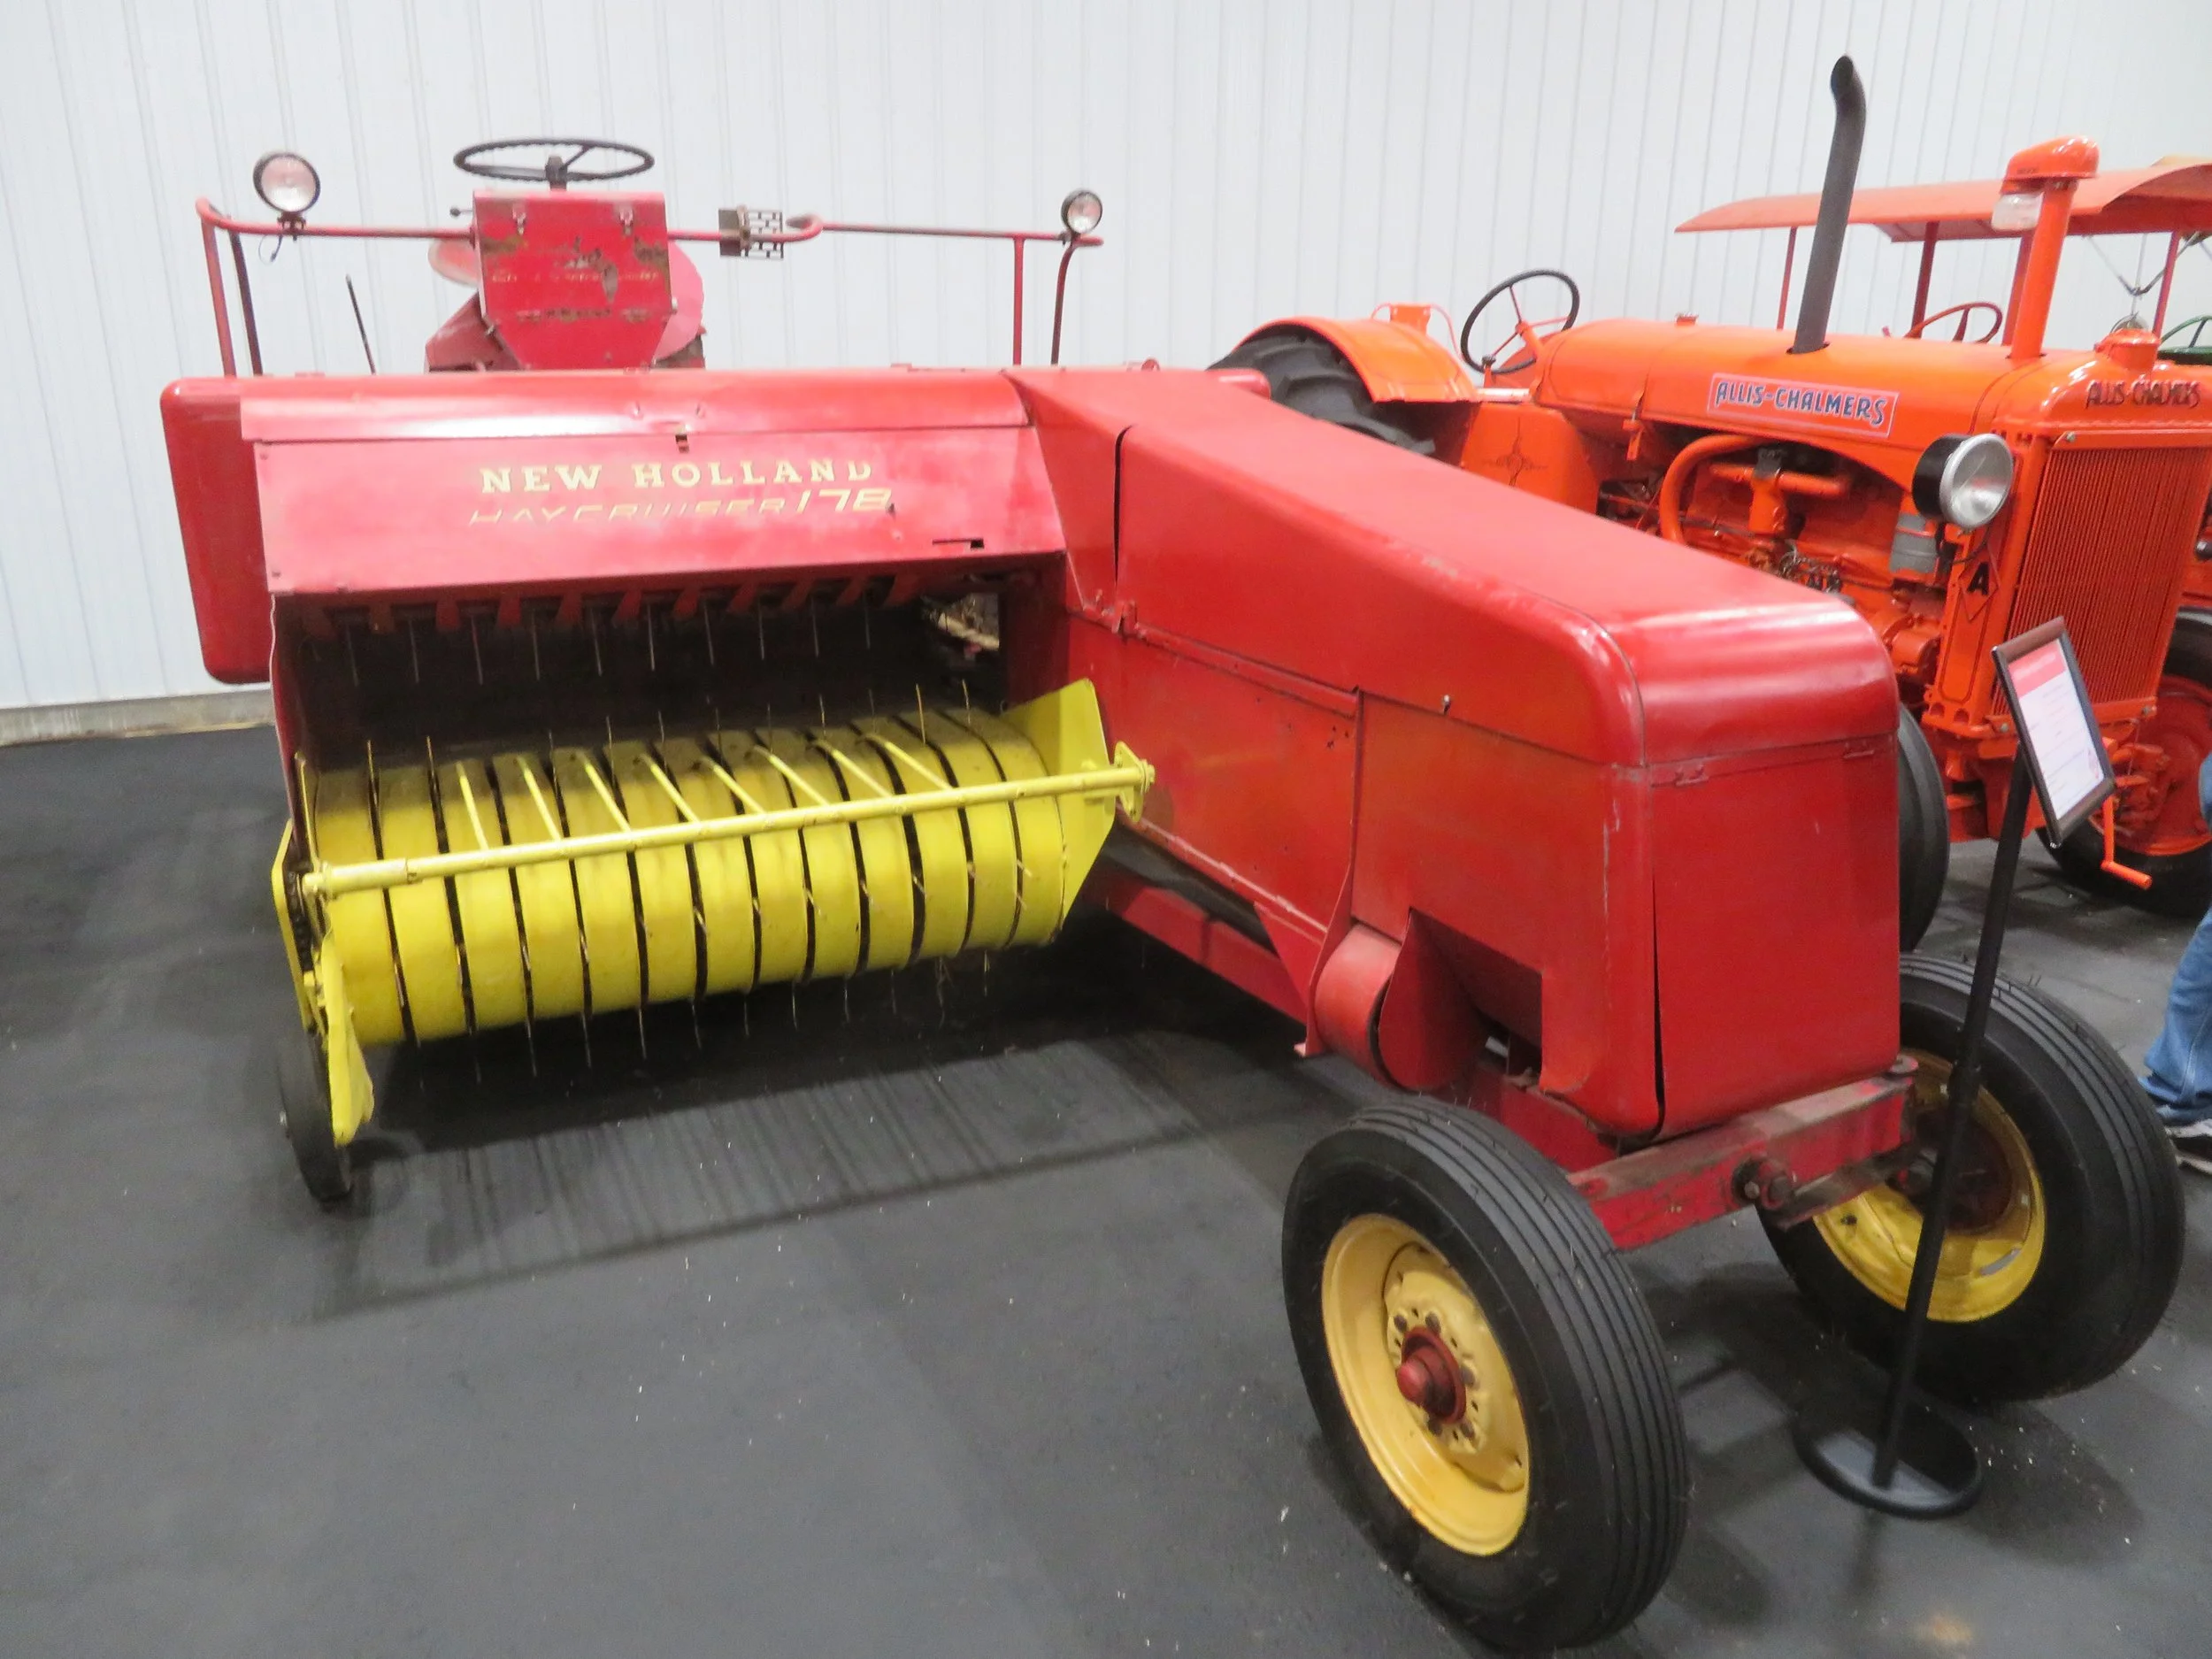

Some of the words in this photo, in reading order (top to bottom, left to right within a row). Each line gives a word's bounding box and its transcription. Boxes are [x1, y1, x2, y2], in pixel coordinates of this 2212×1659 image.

[1715, 380, 1886, 426] ALLIS-CHALMERS
[480, 464, 602, 494] NEW
[631, 458, 872, 488] HOLLAND
[796, 488, 892, 515] 178
[1966, 561, 1990, 595] A
